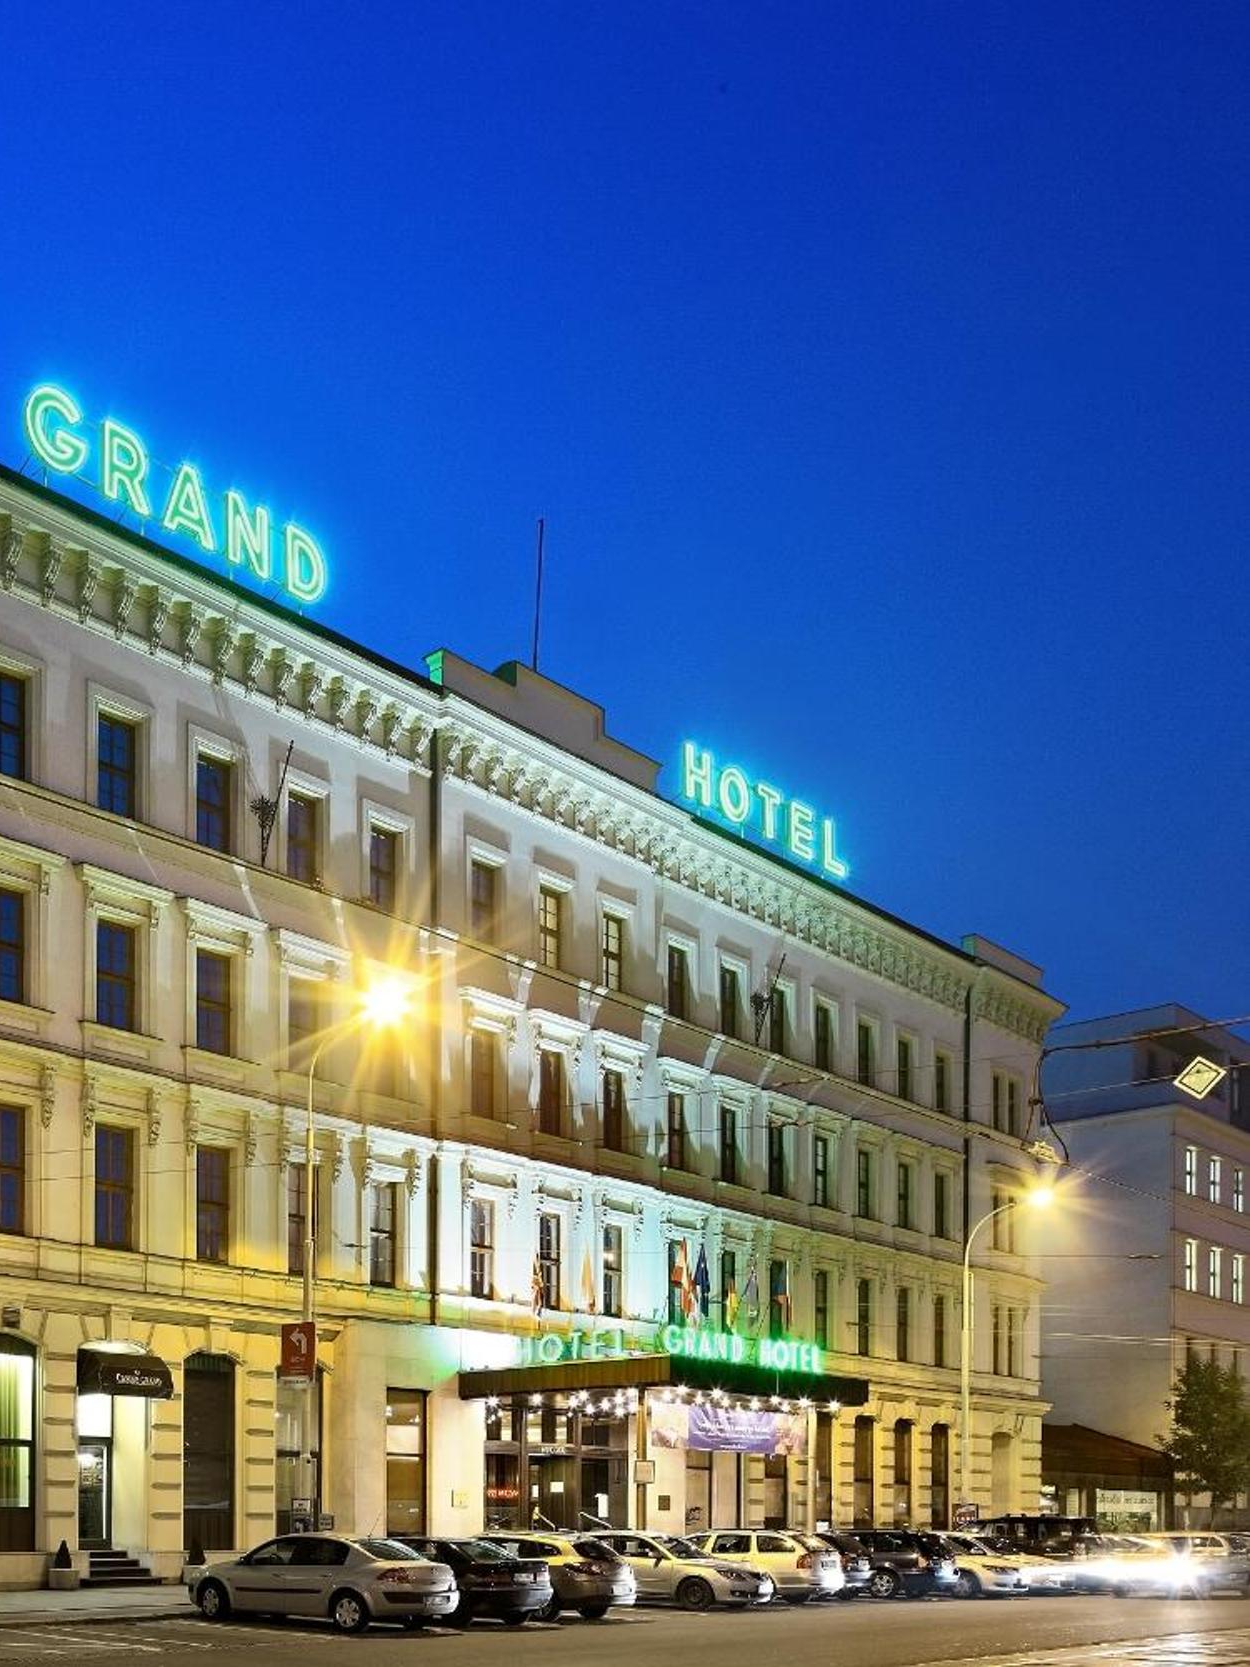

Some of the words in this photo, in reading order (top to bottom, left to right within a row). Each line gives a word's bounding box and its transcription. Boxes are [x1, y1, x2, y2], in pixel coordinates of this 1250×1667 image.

[25, 384, 327, 602] GRAND
[683, 741, 848, 878] HOTEL
[664, 1325, 743, 1363] GRAND
[759, 1337, 824, 1376] HOTEL
